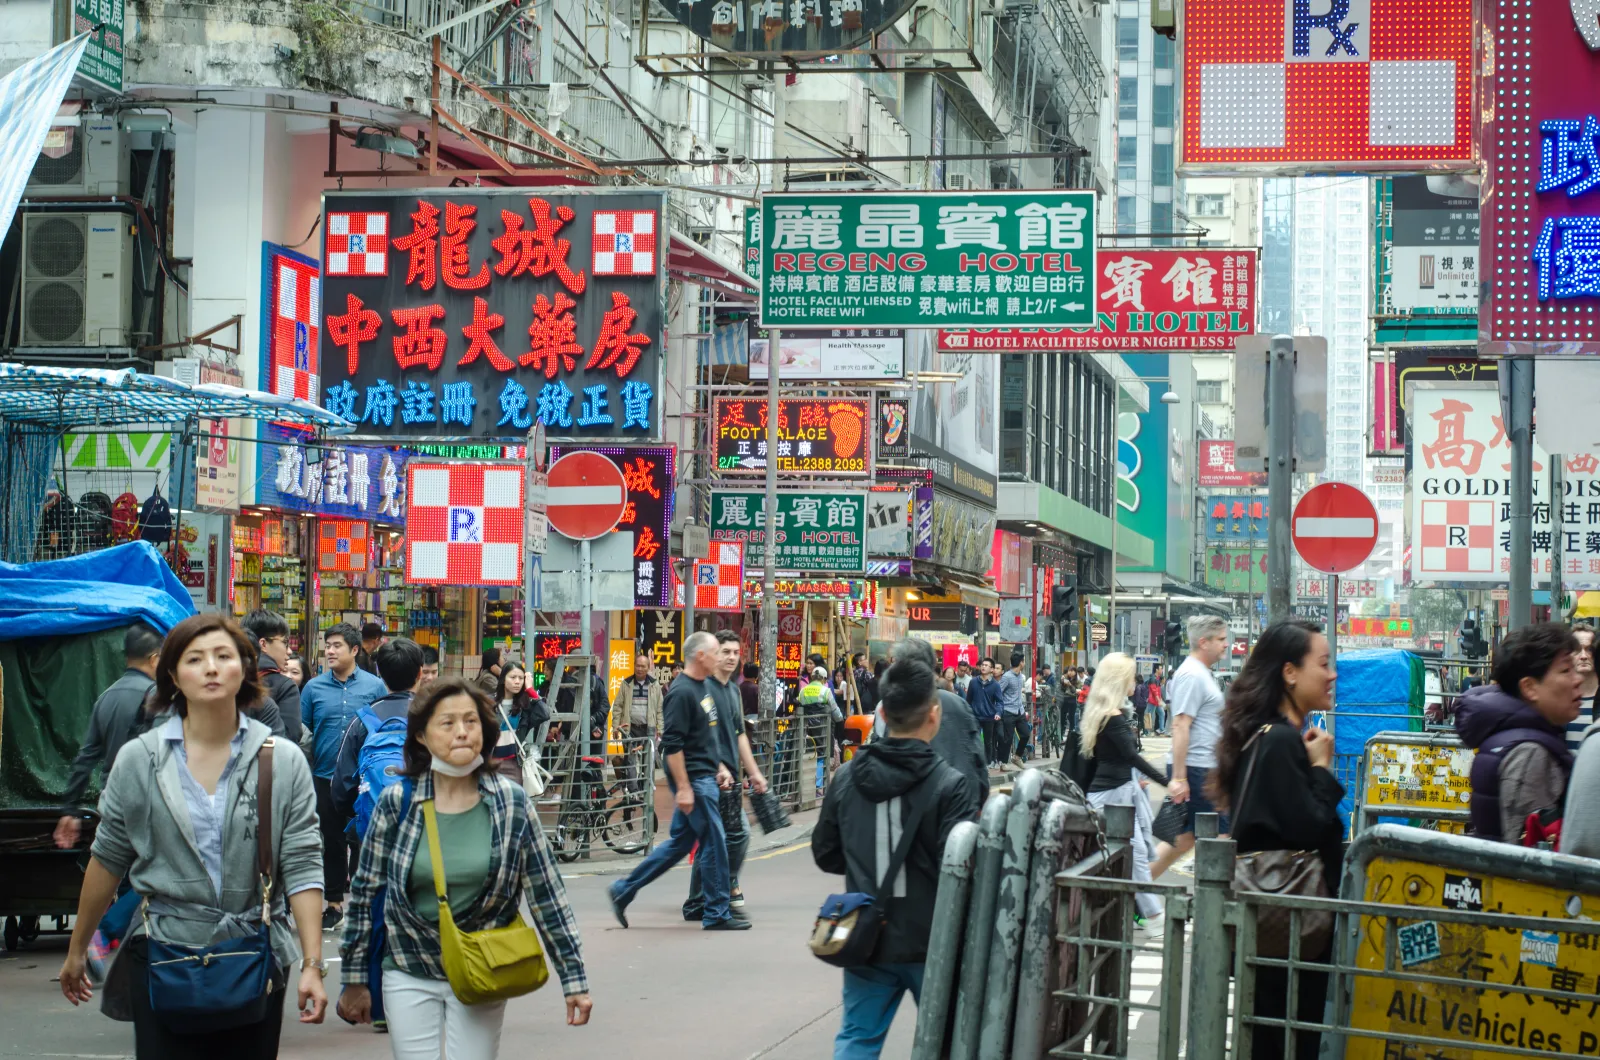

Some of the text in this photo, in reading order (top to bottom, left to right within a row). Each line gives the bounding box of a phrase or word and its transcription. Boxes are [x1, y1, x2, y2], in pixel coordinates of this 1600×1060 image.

[771, 202, 1088, 251] 麗晶賓館
[392, 198, 587, 294] 龍城
[774, 252, 1082, 273] REGENG HOTEL
[769, 275, 1085, 293] 持牌賓館 酒店設備 豪華套房 歡迎自由行
[1101, 256, 1218, 312] 賓館
[1222, 255, 1234, 309] 全日特平
[1236, 255, 1248, 310] 時租過夜
[1437, 271, 1475, 280] Unlimited
[769, 296, 912, 306] HOTEL FACILITY LIENSED
[918, 296, 999, 316] 免費wifi上網
[769, 308, 865, 317] HOTEL FREE WIFI
[1126, 311, 1249, 333] HOTEL
[326, 291, 652, 379] 中西大藥房
[973, 336, 1020, 348] HOTEL
[1023, 336, 1099, 348] FACILITEIS
[1102, 336, 1139, 348] OVER
[1142, 336, 1187, 348] NIGHT
[1191, 336, 1225, 348] LESS
[325, 378, 654, 430] 政府註冊 免稅正貨
[720, 427, 761, 440] FOOT
[719, 457, 740, 468] 2/F
[834, 458, 864, 469] 2093
[717, 496, 858, 528] 麗晶賓館
[802, 531, 860, 545] HOTEL
[774, 583, 795, 592] ODY
[796, 583, 851, 592] MASSAGE
[783, 616, 802, 633] $38
[1457, 947, 1600, 1019] 行人專
[1387, 989, 1427, 1026] All
[1440, 998, 1562, 1053] Vehicles
